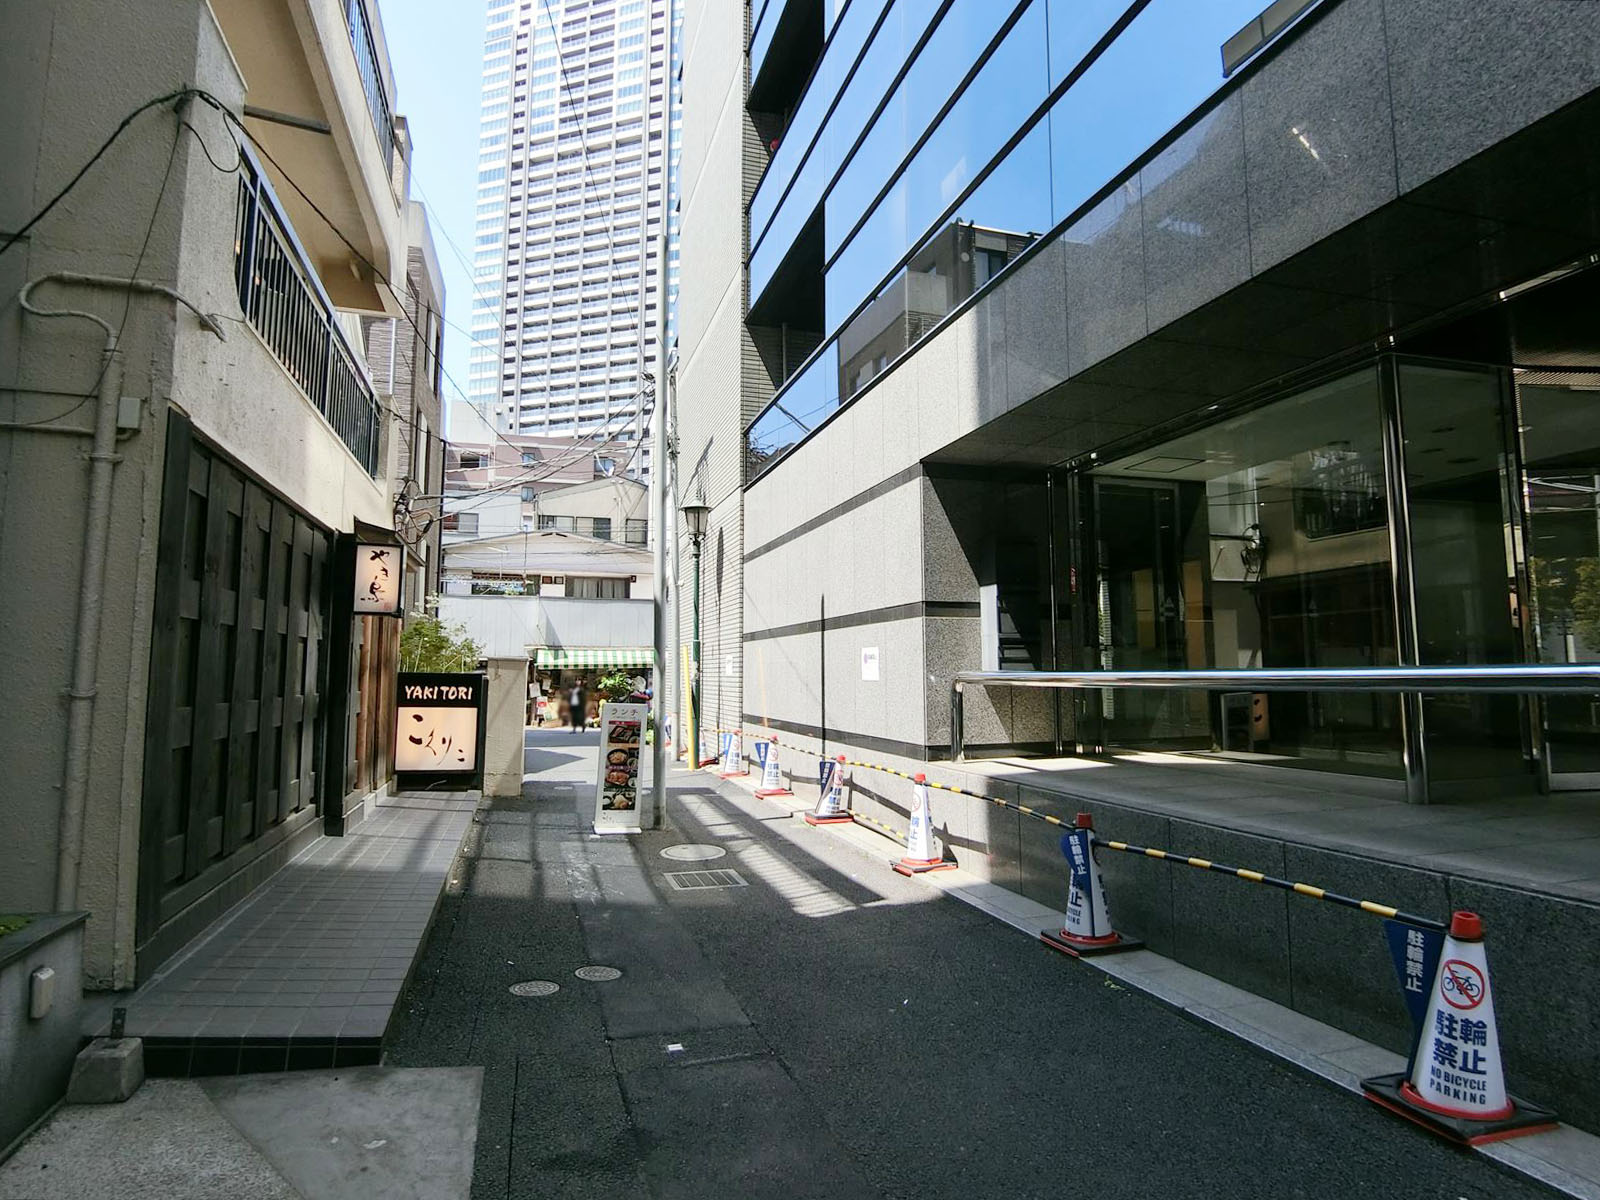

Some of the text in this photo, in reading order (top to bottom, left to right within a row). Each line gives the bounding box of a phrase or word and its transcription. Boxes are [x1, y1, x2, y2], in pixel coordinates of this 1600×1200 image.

[1069, 834, 1087, 875] 駐輪禁止
[1405, 929, 1425, 993] 駐輪禁止
[1434, 1008, 1488, 1048] 駐輪
[1432, 1036, 1488, 1076] 禁止
[1429, 1079, 1487, 1106] PARKING
[1430, 1064, 1487, 1092] NO BICYCLE
